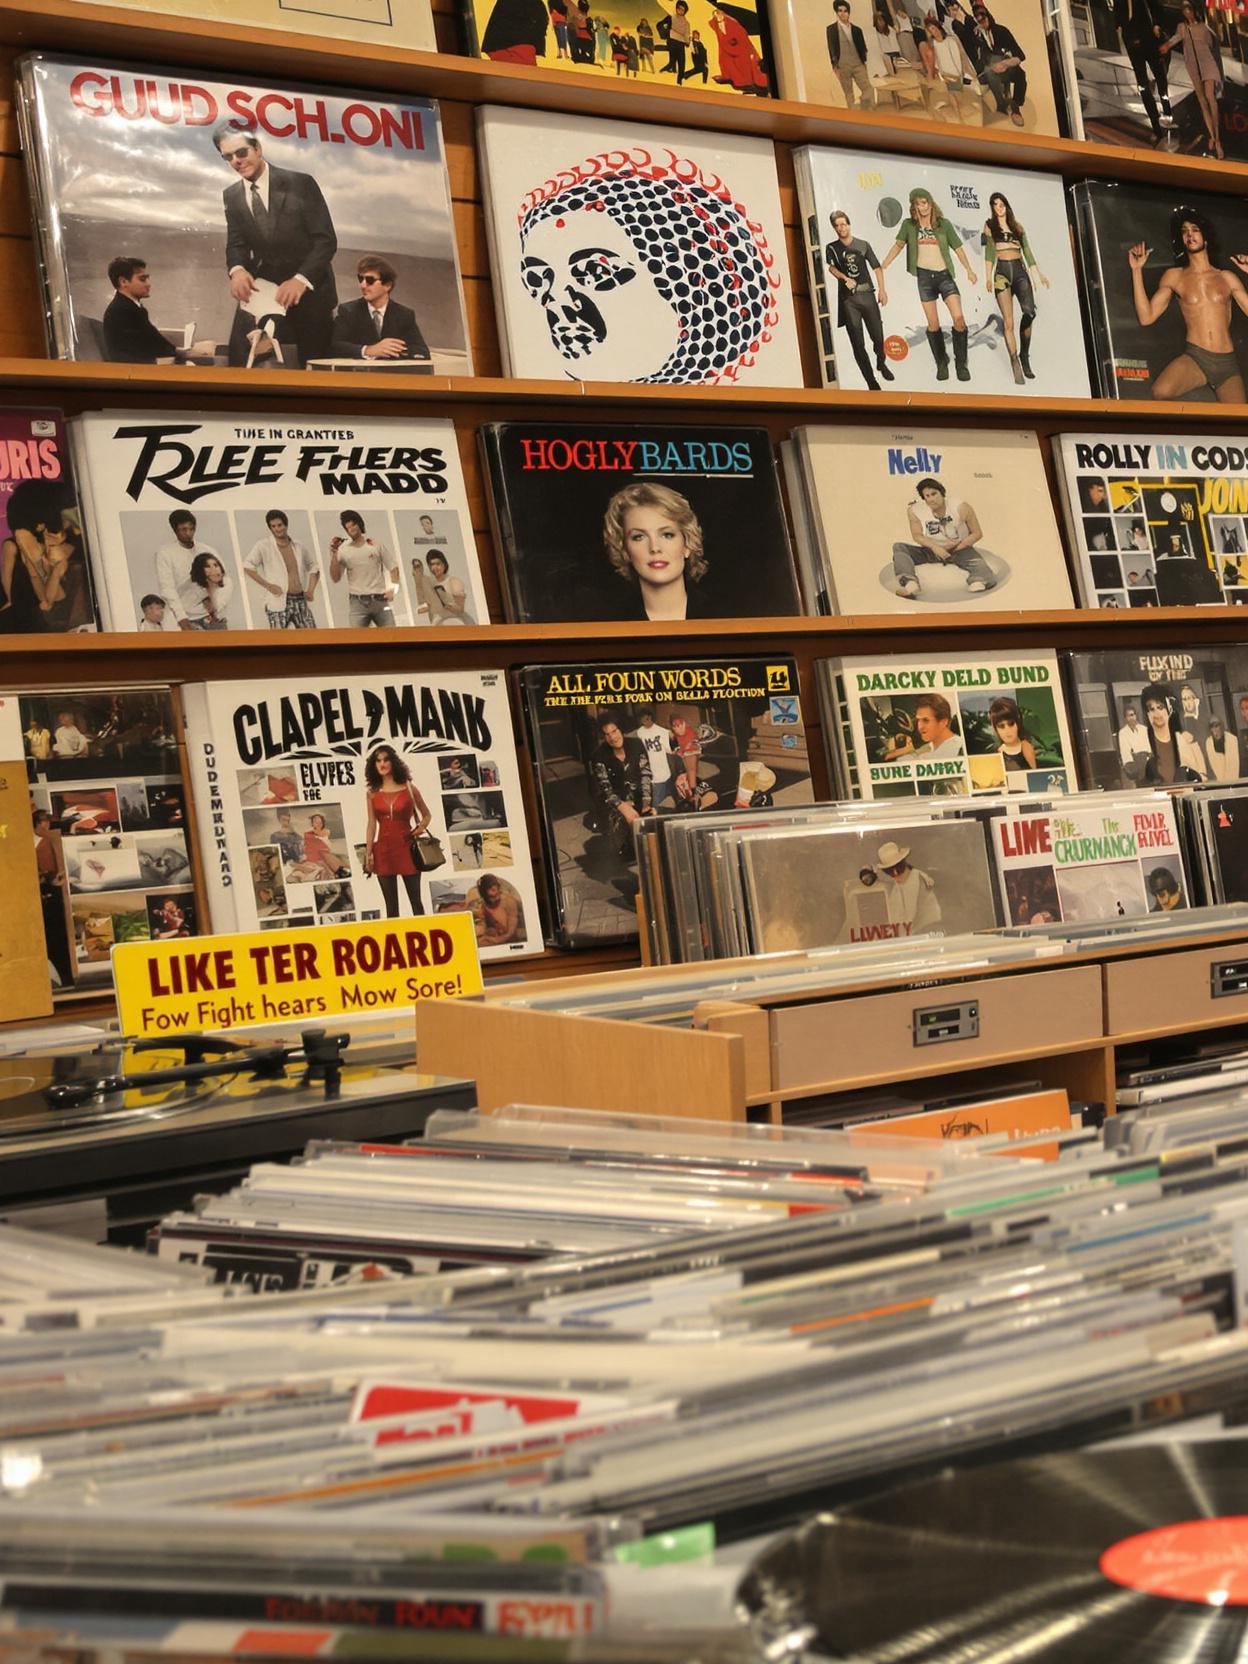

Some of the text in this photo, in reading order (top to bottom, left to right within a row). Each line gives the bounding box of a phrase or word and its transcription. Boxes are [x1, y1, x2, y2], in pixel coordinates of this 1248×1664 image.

[70, 71, 219, 126] GUUD
[269, 428, 284, 440] IN
[887, 447, 943, 475] Nelly
[1075, 443, 1152, 469] ROLLY
[1156, 445, 1188, 469] IN
[319, 472, 449, 495] MADD
[546, 676, 592, 695] ALL
[659, 668, 742, 690] WORDS
[857, 665, 1050, 692] DARCKY DELD BUND
[147, 950, 236, 998] LIKE
[249, 943, 322, 985] TER
[142, 974, 464, 1031] Fow Fight hears Mow Sore!
